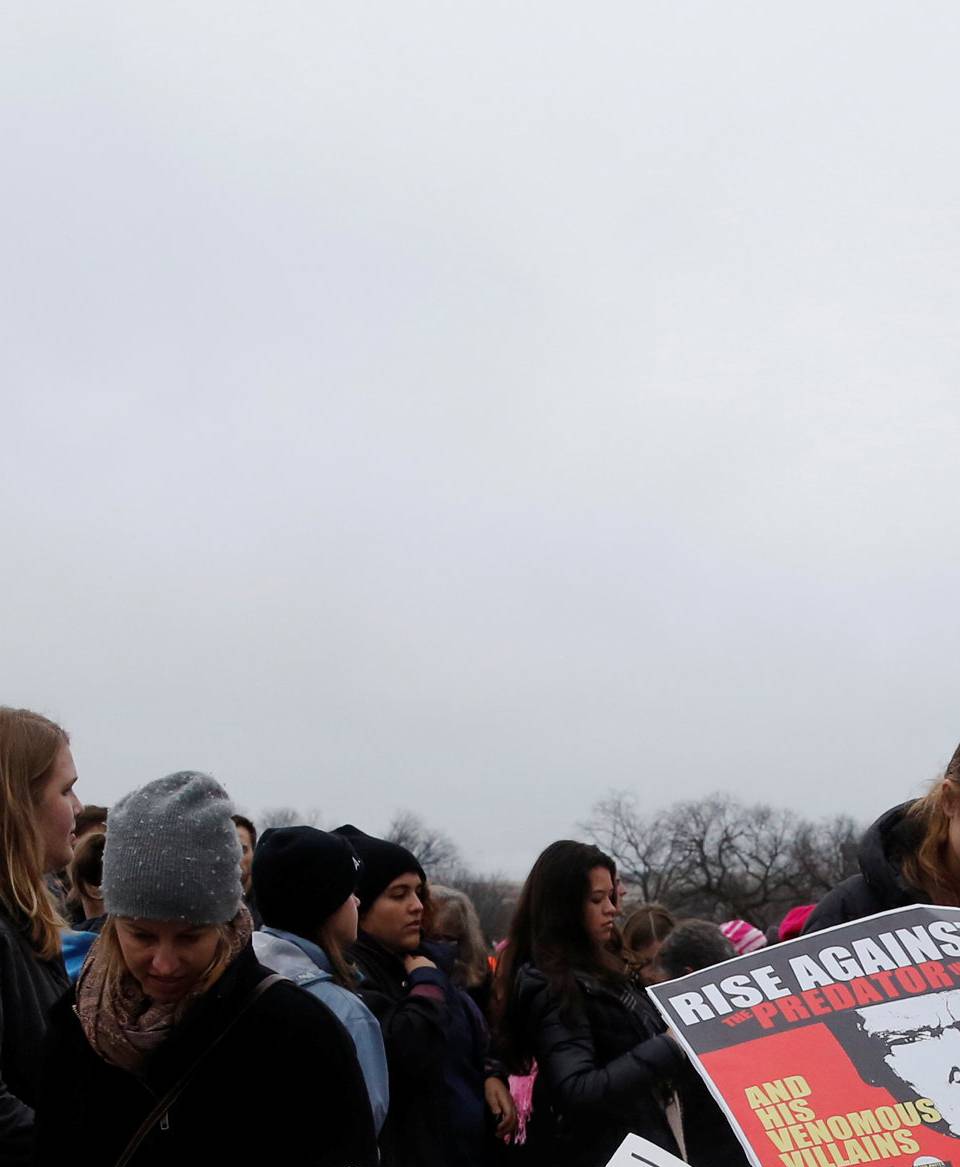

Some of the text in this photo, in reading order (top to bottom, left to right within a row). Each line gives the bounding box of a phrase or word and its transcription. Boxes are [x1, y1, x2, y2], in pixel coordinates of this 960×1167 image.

[668, 966, 791, 1026] RISE
[721, 961, 955, 1029] THE PREDATOR
[744, 1075, 813, 1110] AND
[754, 1098, 816, 1131] HIS
[764, 1098, 943, 1153] VENOMOUS
